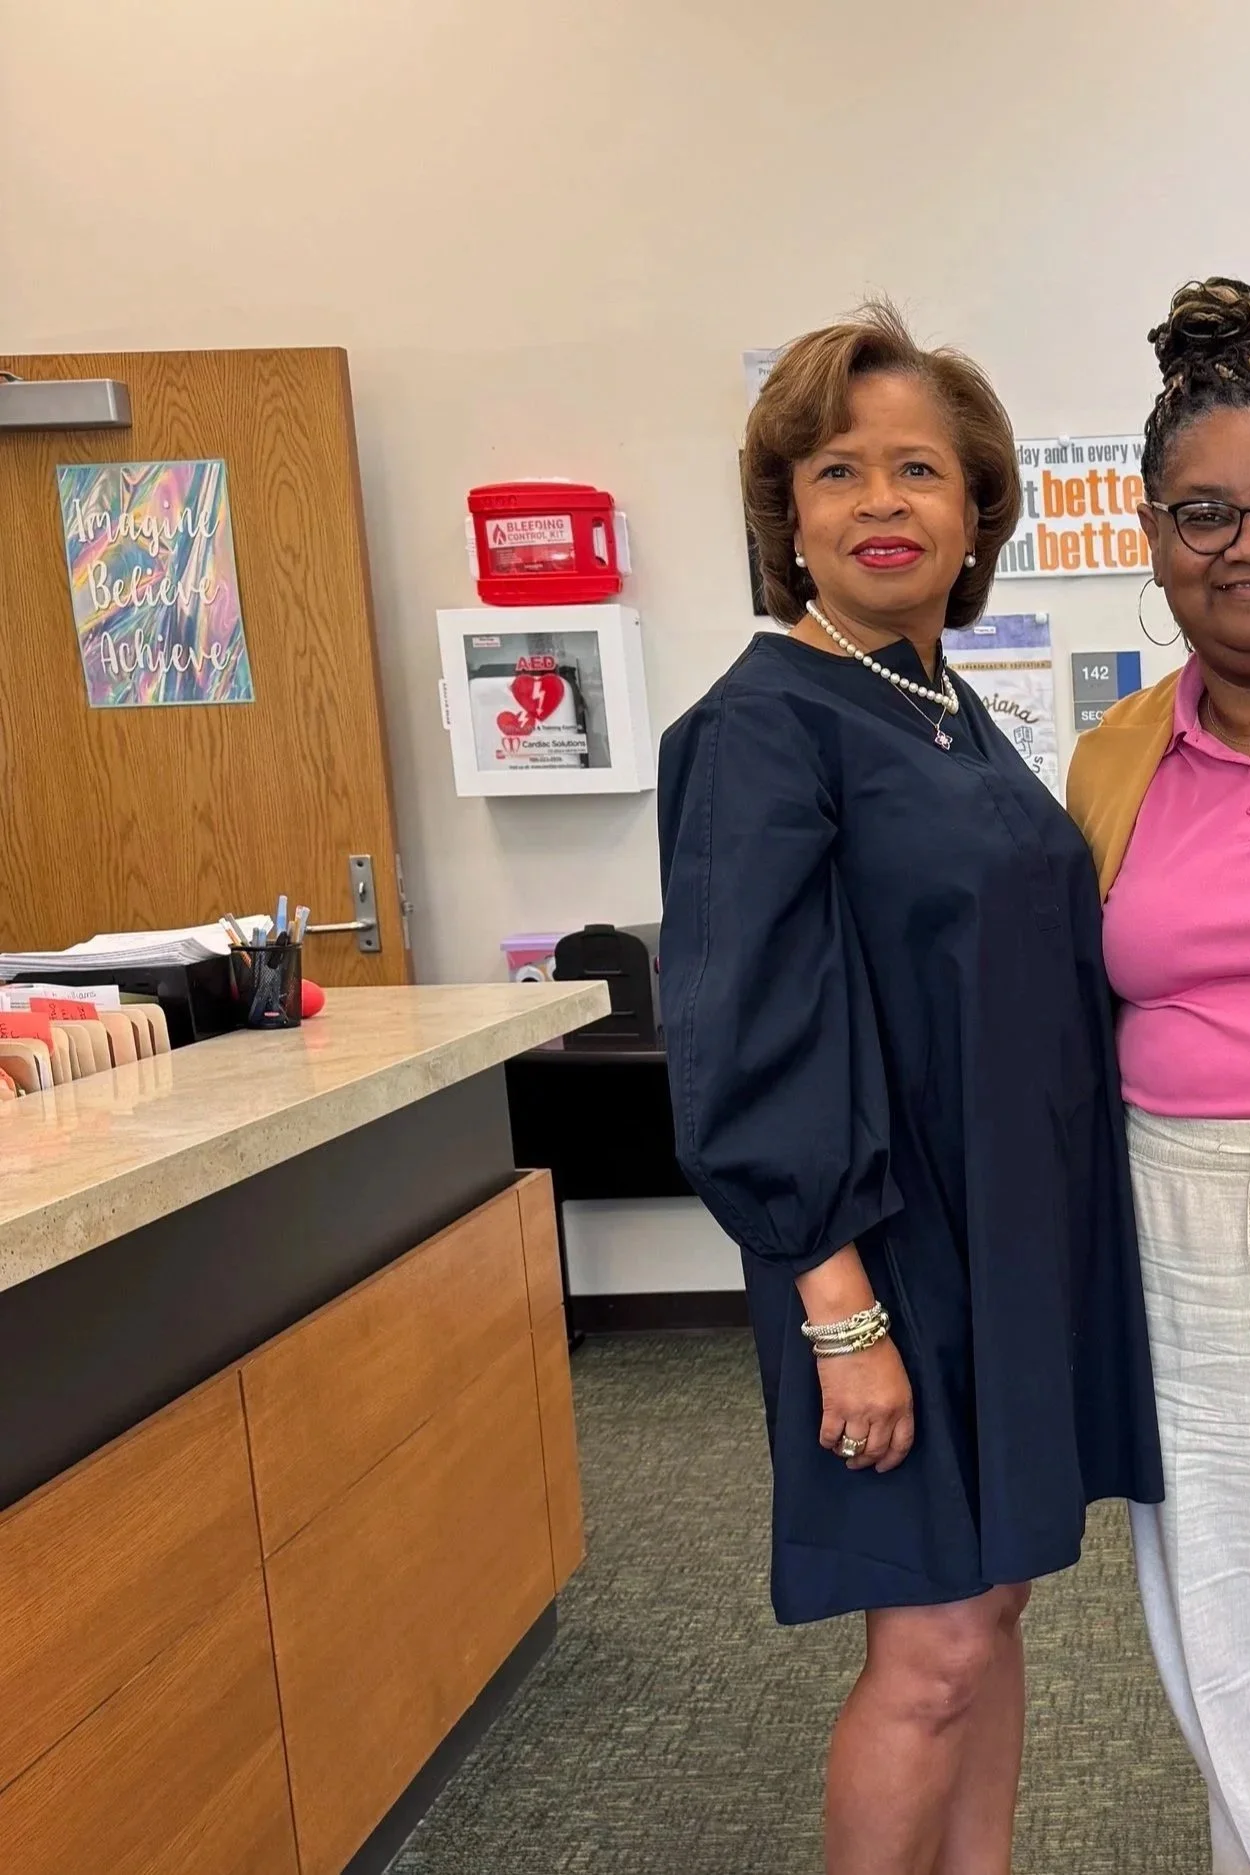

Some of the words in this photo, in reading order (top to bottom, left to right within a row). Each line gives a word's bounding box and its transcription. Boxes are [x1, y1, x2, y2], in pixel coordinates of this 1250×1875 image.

[1044, 445, 1068, 464] and
[1071, 443, 1084, 463] in
[1088, 443, 1128, 464] every
[1042, 468, 1144, 519] bette
[68, 498, 220, 557] Imagine
[506, 519, 564, 533] BLEEDING
[507, 531, 547, 541] CONTROL
[550, 530, 564, 539] KIT
[996, 533, 1035, 572] nd
[88, 559, 220, 614] Believe
[100, 628, 233, 674] Achieve
[516, 655, 557, 671] AED
[1082, 666, 1109, 680] 142
[982, 693, 1039, 724] siana
[1081, 711, 1103, 721] SEC
[522, 740, 550, 748] Cardiac
